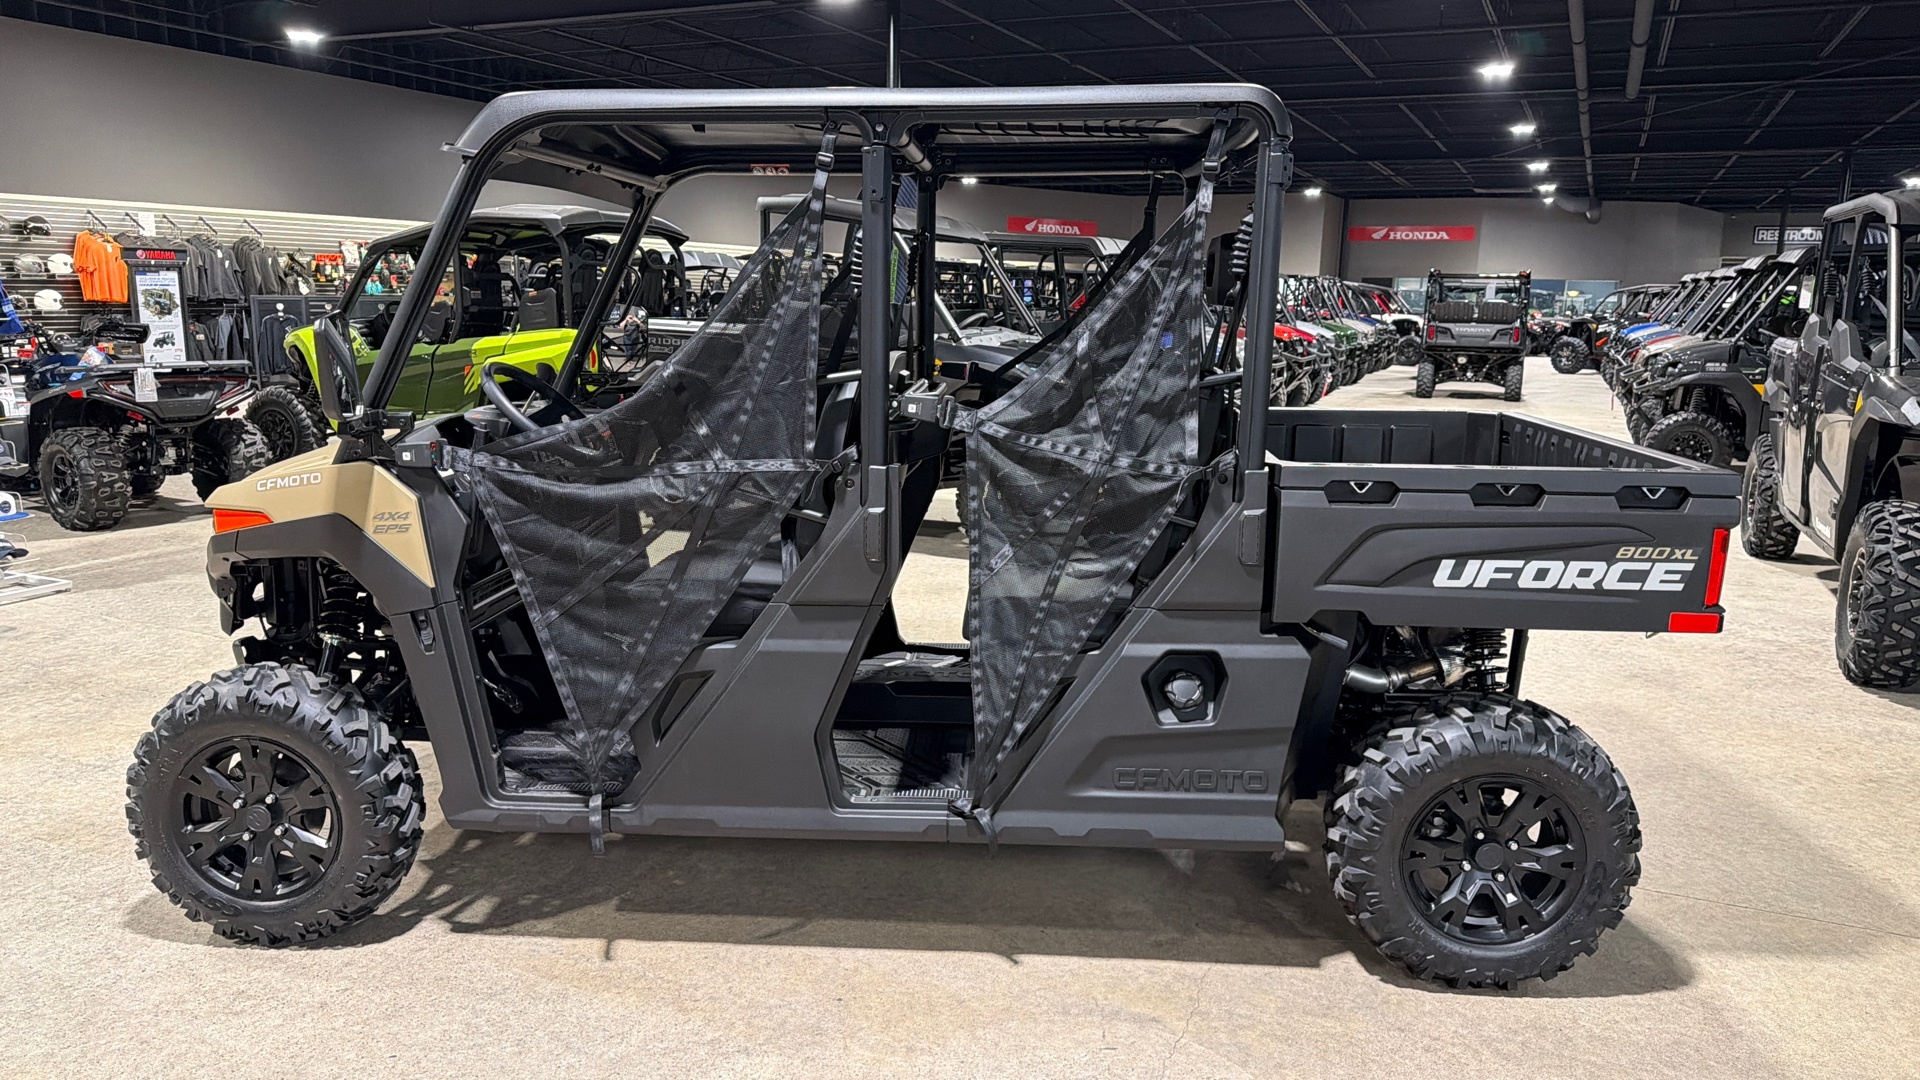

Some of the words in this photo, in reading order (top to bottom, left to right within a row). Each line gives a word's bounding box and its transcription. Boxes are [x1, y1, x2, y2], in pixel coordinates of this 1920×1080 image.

[1038, 224, 1080, 234] HONDA
[1388, 231, 1449, 239] HONDA
[145, 250, 176, 260] YAMAHA
[256, 472, 322, 492] CFMOTO
[373, 511, 411, 522] 4X4
[372, 523, 412, 534] EPS
[1615, 546, 1700, 560] 800XL
[1432, 559, 1696, 592] UFORCE
[1113, 767, 1269, 794] CFMOTO
